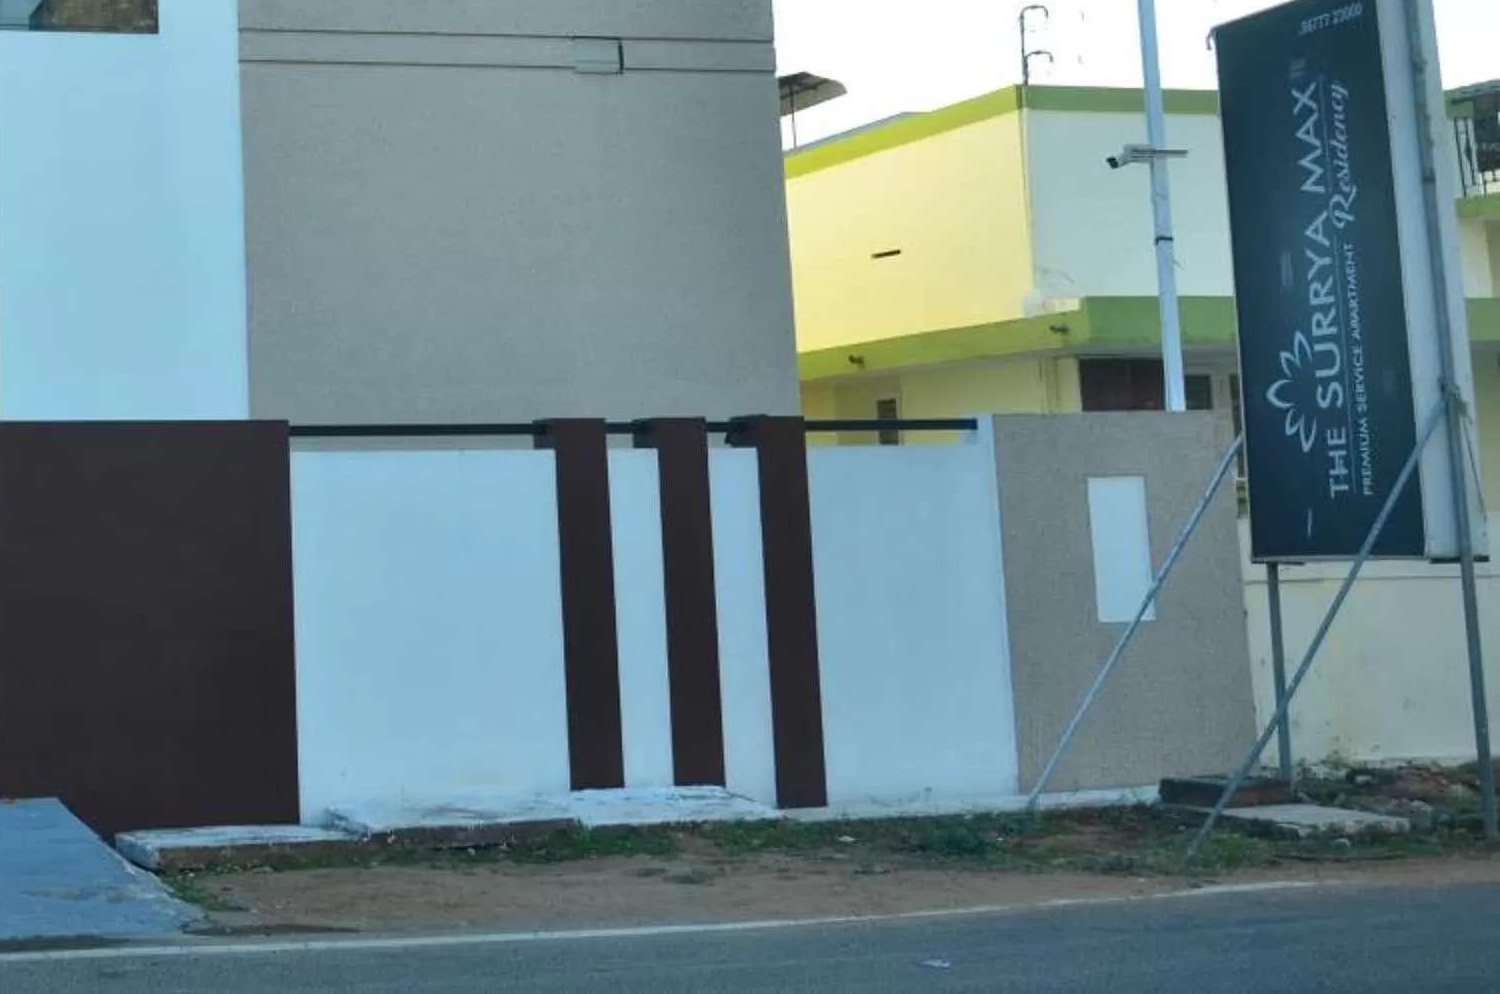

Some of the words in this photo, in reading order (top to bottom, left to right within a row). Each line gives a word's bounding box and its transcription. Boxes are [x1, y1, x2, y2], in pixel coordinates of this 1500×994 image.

[1291, 81, 1326, 193] MAX
[1329, 79, 1357, 230] Residency
[1304, 210, 1344, 409] SURRYA
[1343, 243, 1363, 340] APARTMENT
[1352, 345, 1367, 413] SERVICE
[1327, 426, 1349, 499] THE
[1355, 418, 1373, 495] PREMIUM
